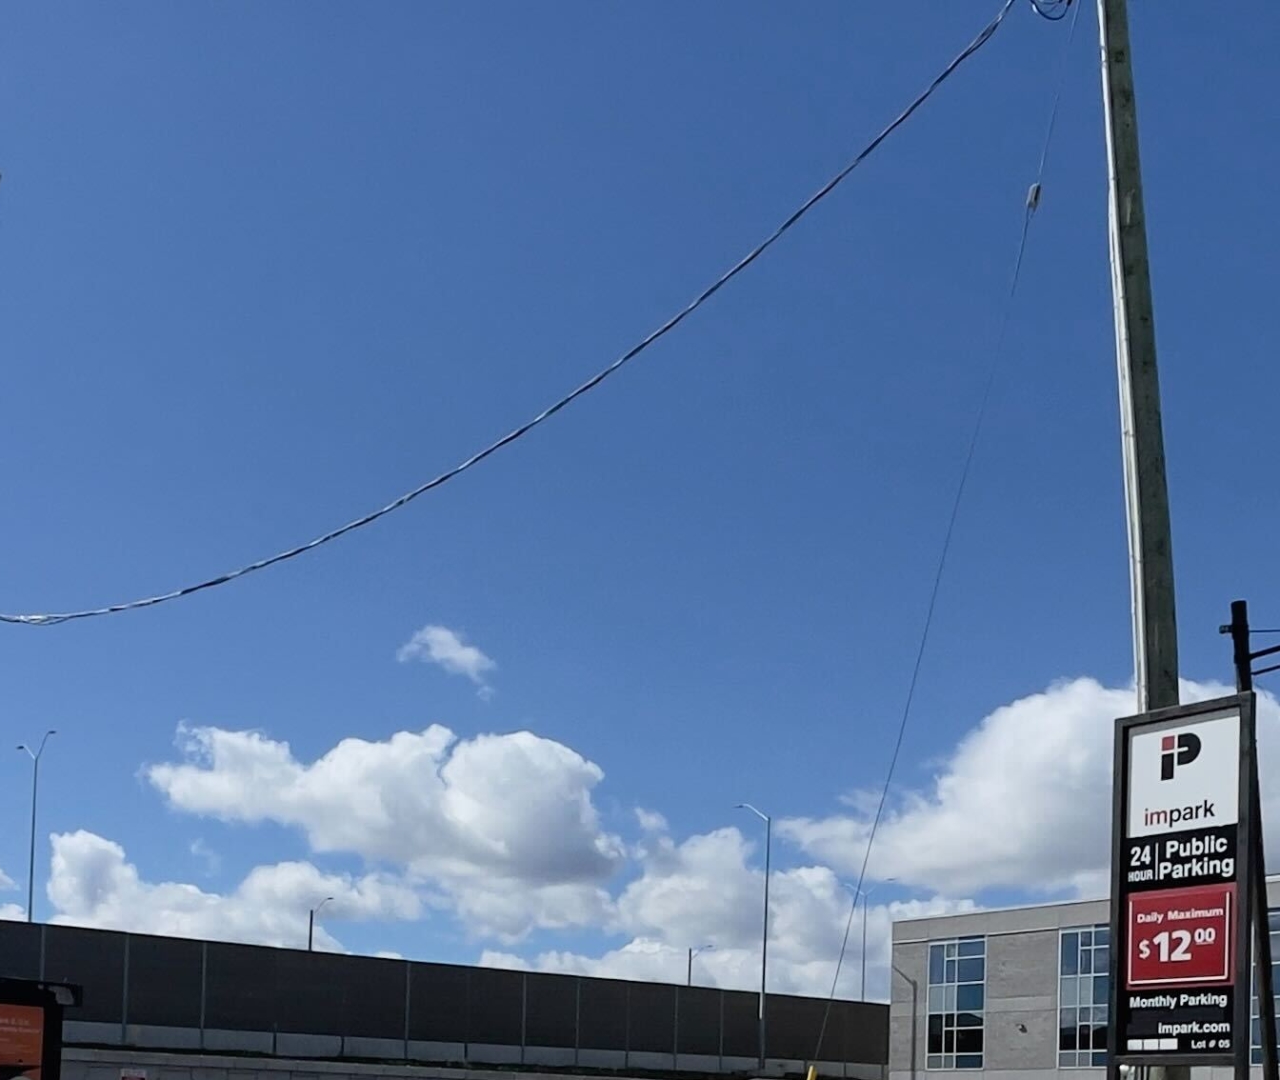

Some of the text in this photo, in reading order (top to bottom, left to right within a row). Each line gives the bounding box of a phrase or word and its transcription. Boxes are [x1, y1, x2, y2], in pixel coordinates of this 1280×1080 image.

[1144, 799, 1216, 828] impark
[1130, 845, 1151, 867] 24
[1165, 835, 1228, 859] Public
[1127, 869, 1154, 882] HOUR
[1159, 857, 1234, 880] Parking
[1137, 908, 1224, 924] Daily Maximum
[1129, 993, 1228, 1009] Monthly Parking
[1191, 1039, 1206, 1049] Lot
[1218, 1039, 1231, 1048] 05
